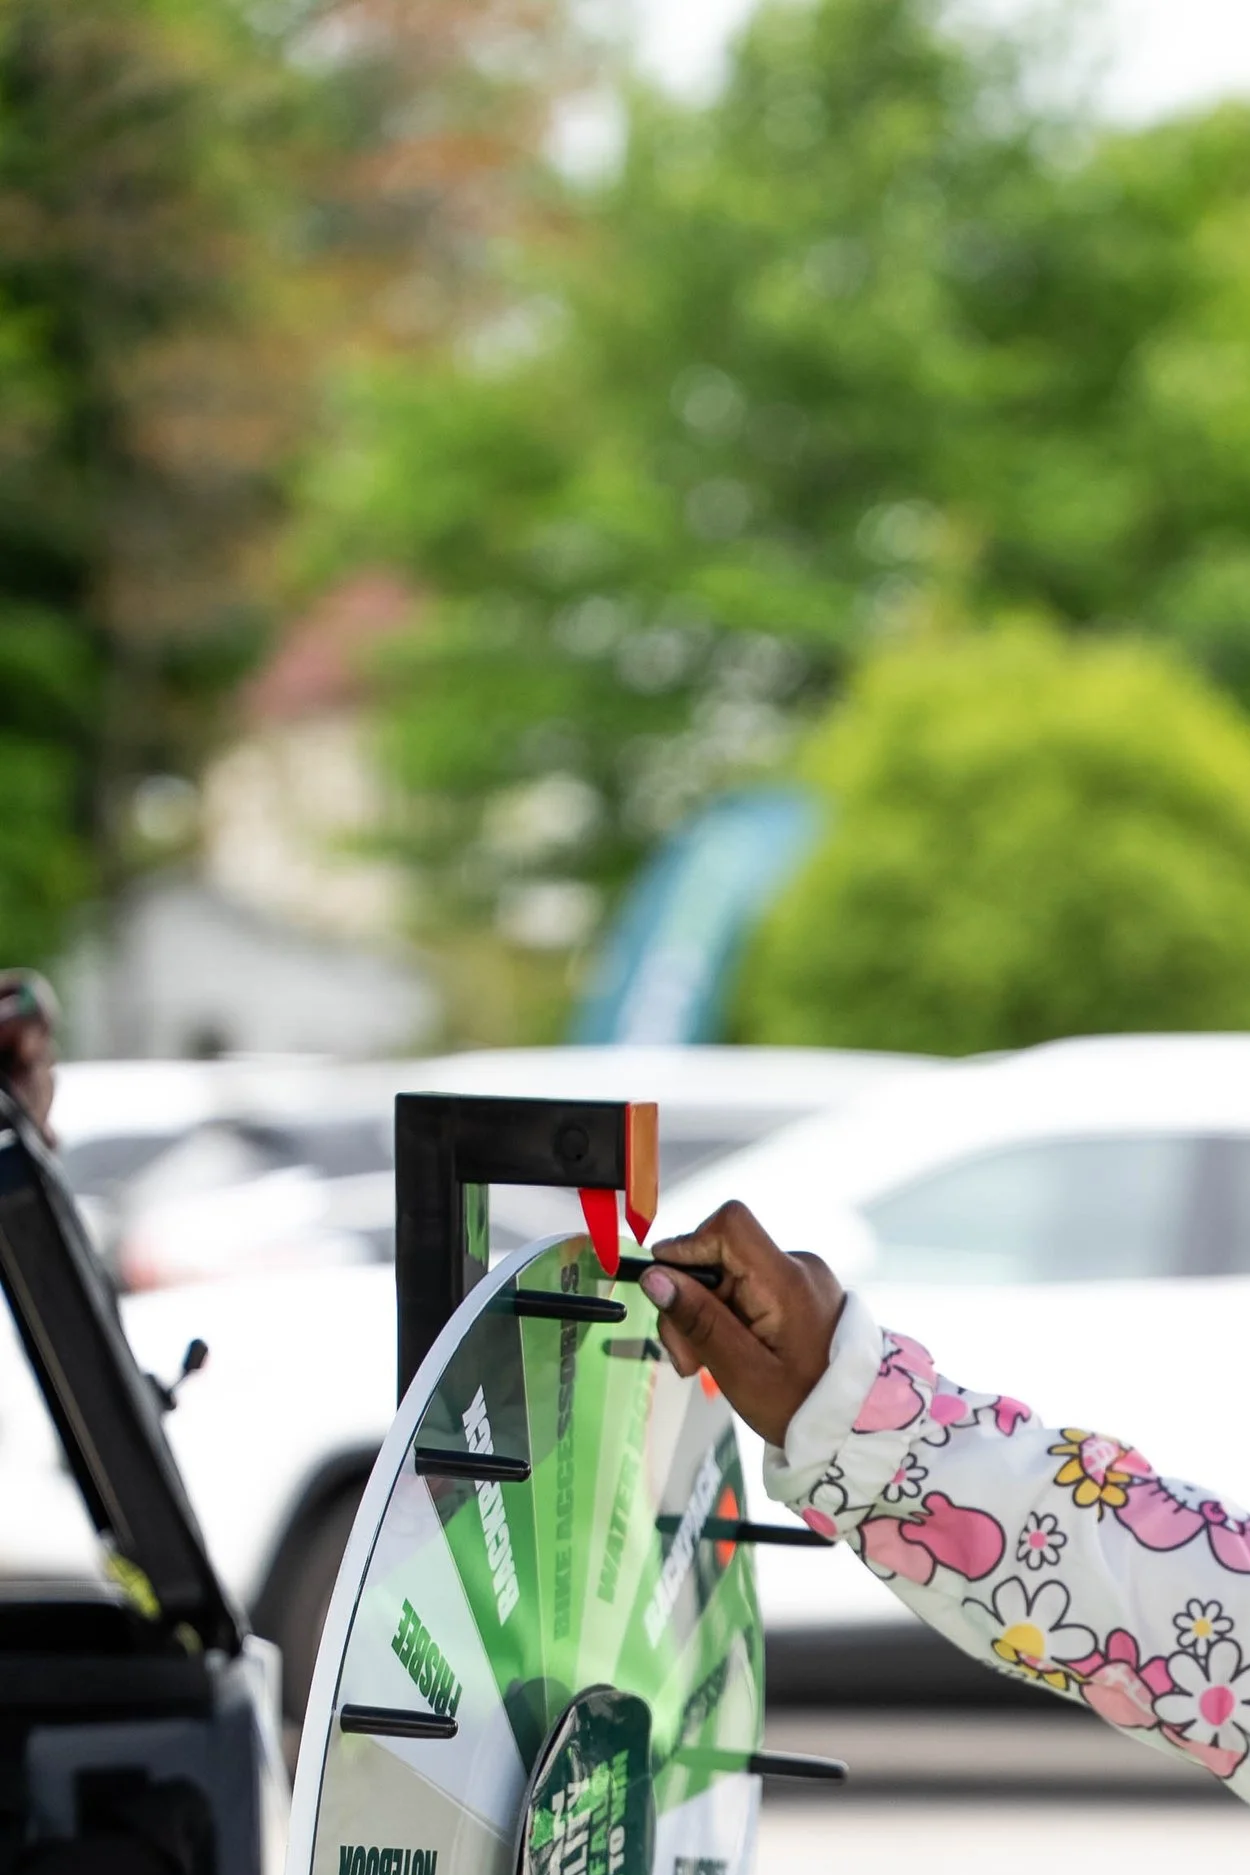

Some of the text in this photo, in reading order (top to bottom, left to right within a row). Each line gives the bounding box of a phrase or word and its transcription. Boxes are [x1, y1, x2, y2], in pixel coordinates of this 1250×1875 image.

[553, 1262, 580, 1642] BIKE ACCESSORIS
[391, 1597, 462, 1717] FRISBEE
